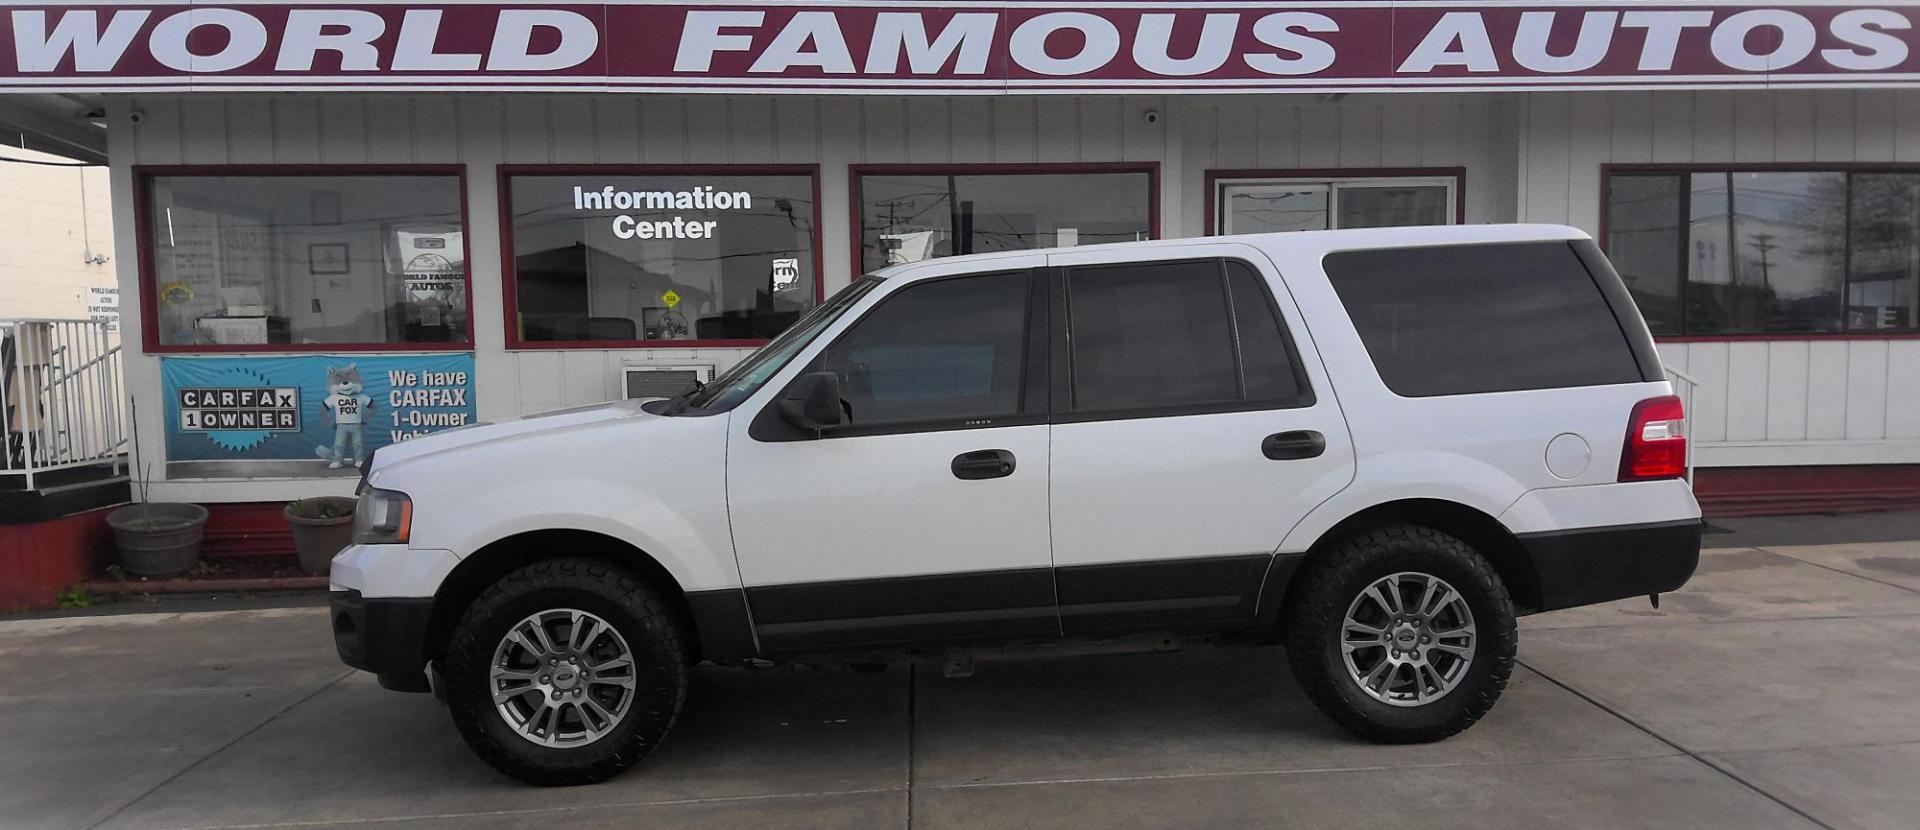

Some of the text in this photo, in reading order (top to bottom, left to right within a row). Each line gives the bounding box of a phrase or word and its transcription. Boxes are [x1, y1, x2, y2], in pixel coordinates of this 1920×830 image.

[10, 8, 1912, 75] WORLD FAMOUS AUTOS
[573, 186, 751, 210] Information
[612, 215, 717, 239] Center
[410, 282, 453, 291] AUTOS
[389, 370, 467, 387] We have
[183, 391, 292, 408] CARFAX
[390, 389, 466, 407] CARFAX
[339, 407, 358, 415] FOX
[391, 410, 467, 427] 1-Owner
